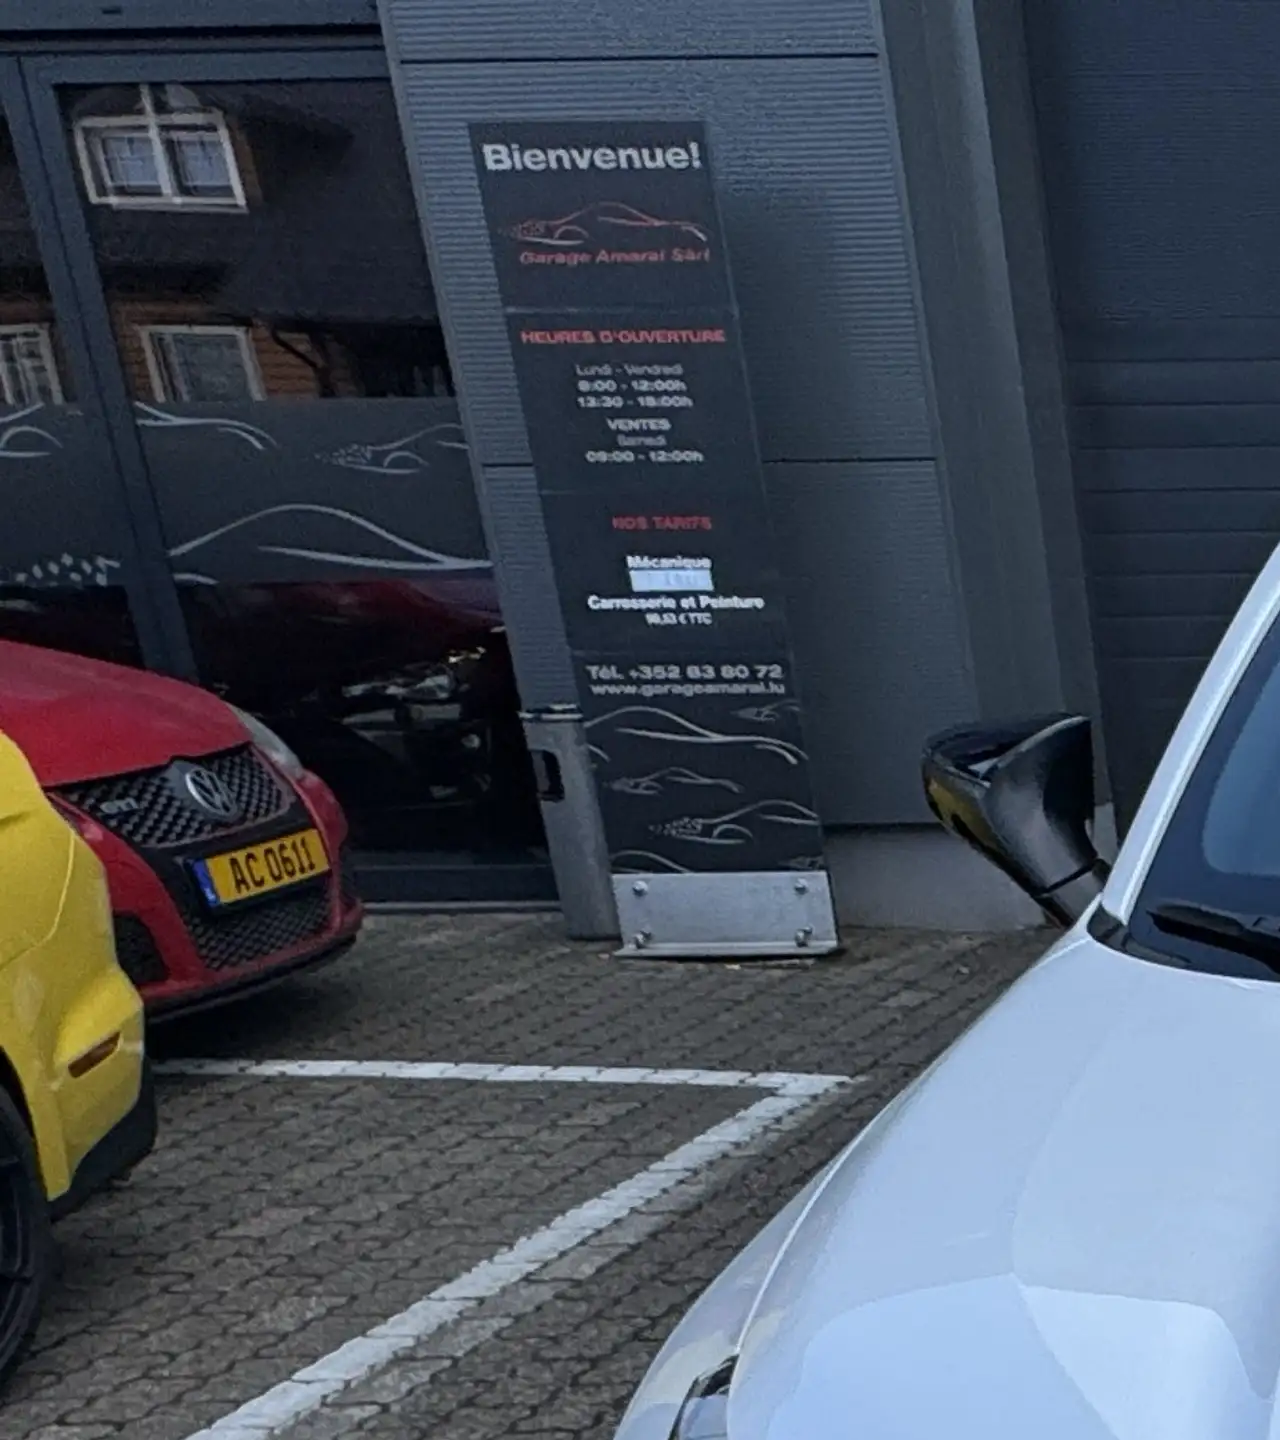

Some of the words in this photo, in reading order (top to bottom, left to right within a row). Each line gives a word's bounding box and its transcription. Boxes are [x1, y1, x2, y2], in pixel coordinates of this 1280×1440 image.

[482, 142, 702, 171] Bienvenue!
[520, 251, 591, 266] Garage
[596, 249, 664, 263] Amaral
[520, 330, 596, 344] HEURES
[605, 417, 672, 431] VENTES
[612, 516, 648, 530] NOS
[626, 555, 712, 569] Mécanique
[588, 594, 676, 610] Carrosserie
[753, 664, 783, 679] 72
[229, 851, 265, 894] AC
[263, 837, 316, 882] 0611
